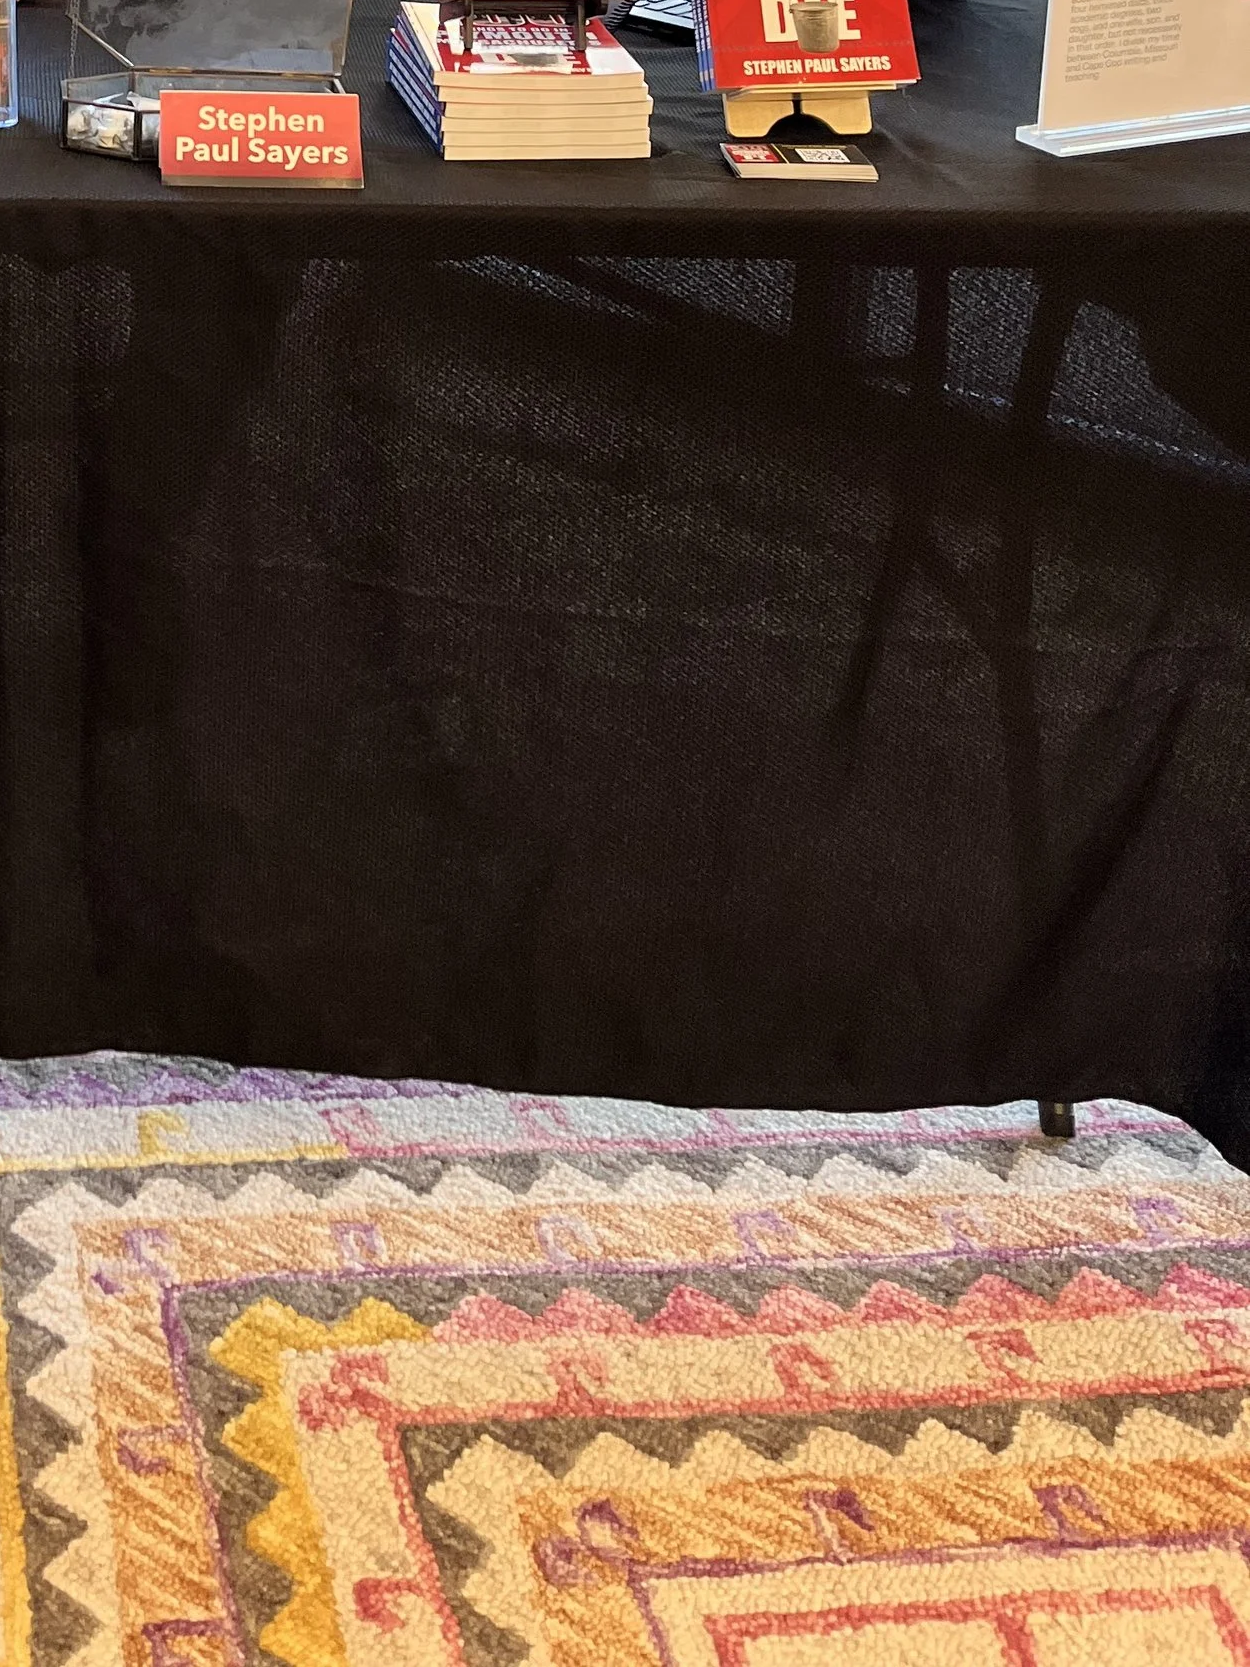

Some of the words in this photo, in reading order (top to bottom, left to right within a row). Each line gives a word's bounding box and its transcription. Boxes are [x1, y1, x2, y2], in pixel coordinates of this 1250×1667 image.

[743, 59, 803, 75] STEPHEN
[804, 58, 839, 73] PAUL
[840, 56, 891, 71] SAYERS
[198, 105, 325, 137] Stephen
[176, 137, 239, 162] Paul
[248, 139, 348, 171] Sayers
